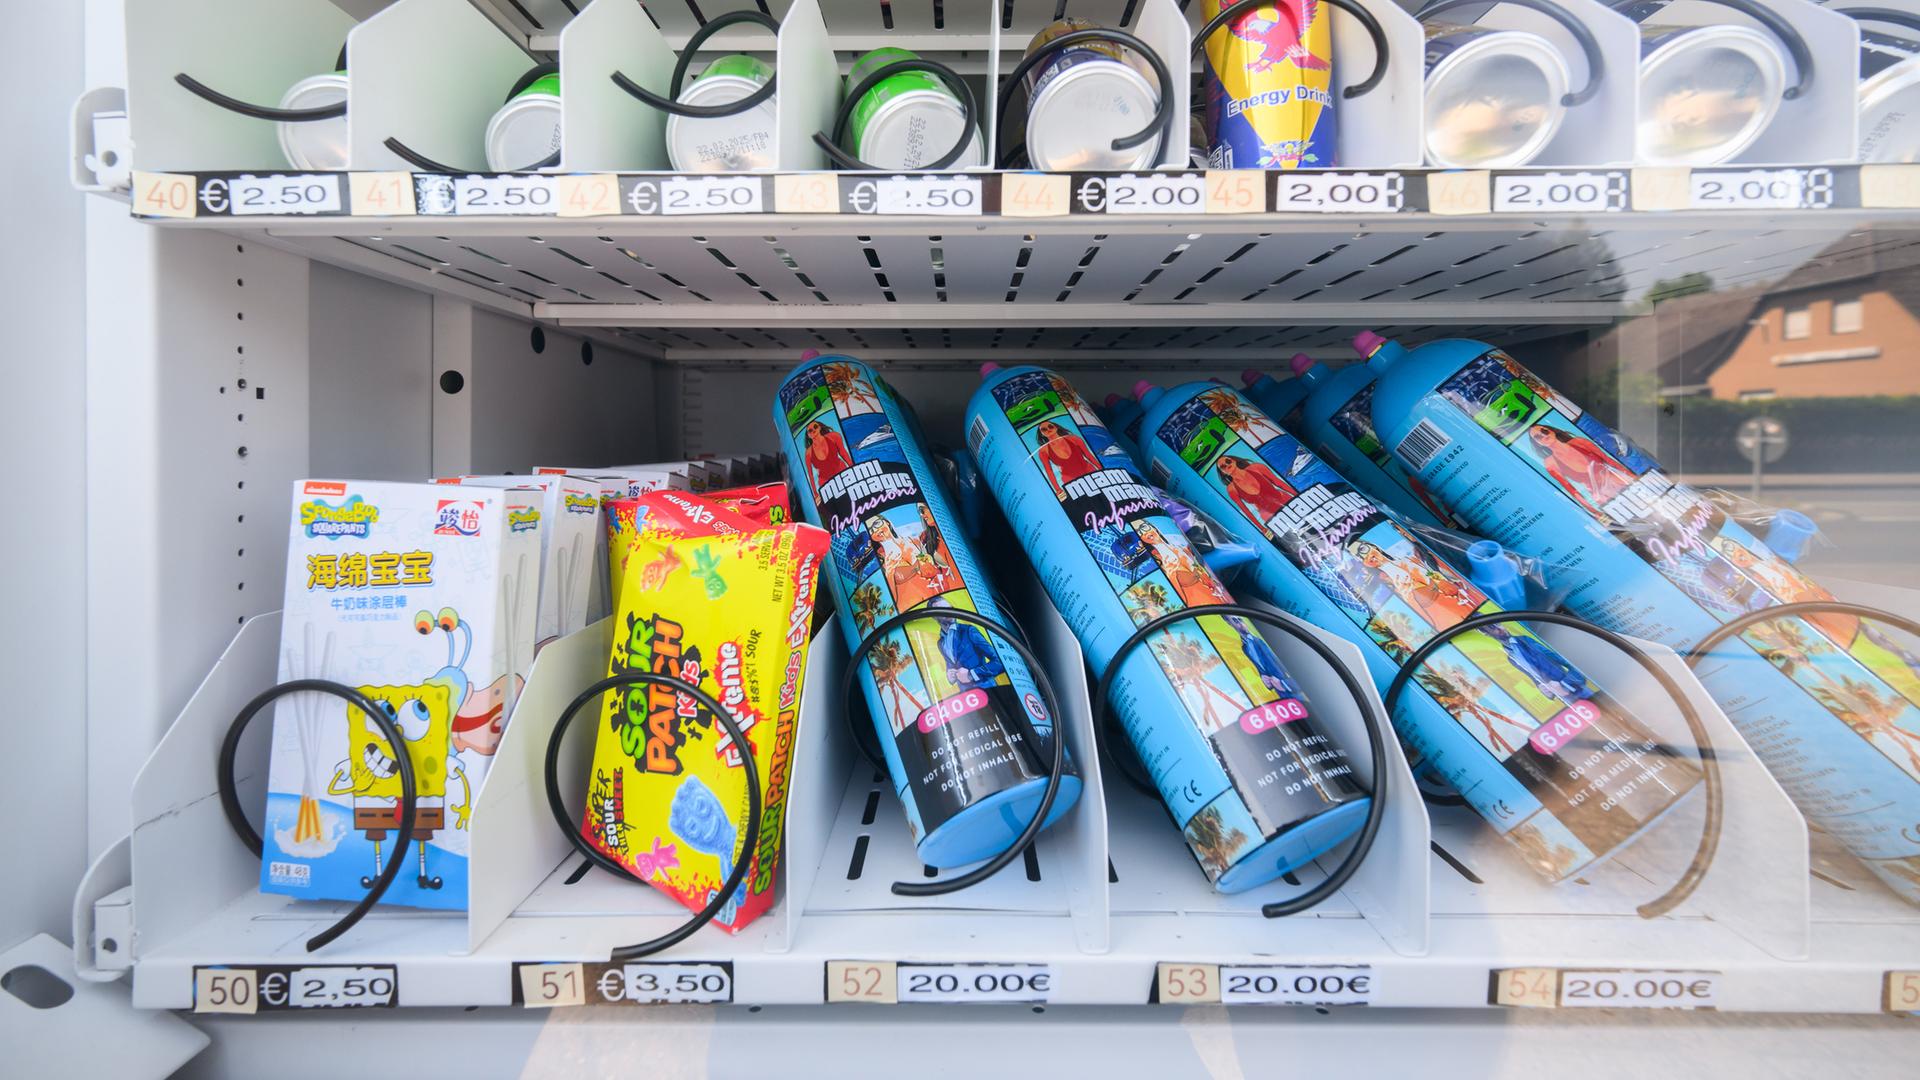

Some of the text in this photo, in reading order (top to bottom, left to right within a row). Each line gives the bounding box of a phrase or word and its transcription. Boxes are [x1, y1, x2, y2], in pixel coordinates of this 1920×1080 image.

[1227, 85, 1333, 118] Energy Drink
[146, 179, 328, 213] 40 € 2.50
[365, 179, 403, 208] 41
[466, 186, 552, 207] 2.50
[569, 181, 755, 215] 42 € 2.50
[848, 180, 877, 214] €
[1012, 177, 1200, 213] 44 € 2.00
[1212, 177, 1379, 209] 45 2,00
[1507, 183, 1598, 206] 2,00
[1700, 180, 1791, 203] 2,00
[1443, 443, 1464, 463] E942
[830, 487, 918, 539] Infusions
[305, 549, 435, 590] 海绵宝宝
[776, 563, 787, 574] 3.5
[778, 551, 789, 561] OZ
[771, 589, 783, 602] NET
[773, 575, 784, 587] WT
[745, 629, 762, 658] SOUR
[621, 619, 654, 760] SOUR
[646, 618, 684, 774] PATCH
[779, 651, 801, 709] Kids
[925, 692, 980, 729] 640G
[1249, 700, 1302, 730] 640G
[1540, 704, 1595, 748] 640G
[931, 744, 945, 760] DO
[967, 722, 1001, 743] REFILL
[1265, 749, 1282, 763] DO
[1302, 734, 1328, 748] REFILL
[765, 709, 794, 807] PATCH
[923, 768, 939, 785] NOT
[961, 740, 1004, 768] MEDICAL
[1004, 731, 1024, 748] USE
[941, 777, 954, 792] DO
[977, 754, 1015, 774] INHALE
[1257, 773, 1275, 788] NOT
[1280, 763, 1301, 778] FOR
[1301, 749, 1340, 768] MEDICAL
[1567, 764, 1587, 781] DO
[1585, 750, 1606, 769] NOT
[1284, 783, 1302, 796] DO
[1567, 790, 1587, 808] NOT
[1589, 774, 1610, 793] FOR
[1600, 796, 1618, 813] DO
[1617, 781, 1638, 800] NOT
[604, 798, 619, 846] SOUR
[616, 823, 629, 855] THEN
[754, 803, 783, 897] SOUR
[209, 971, 393, 1006] 50 € 2,50
[540, 969, 726, 1002] 51 € 3,50
[842, 966, 1052, 997] 52 20.00€
[1166, 968, 1371, 997] 53 20.00€
[1509, 970, 1713, 1000] 54 20.00€
